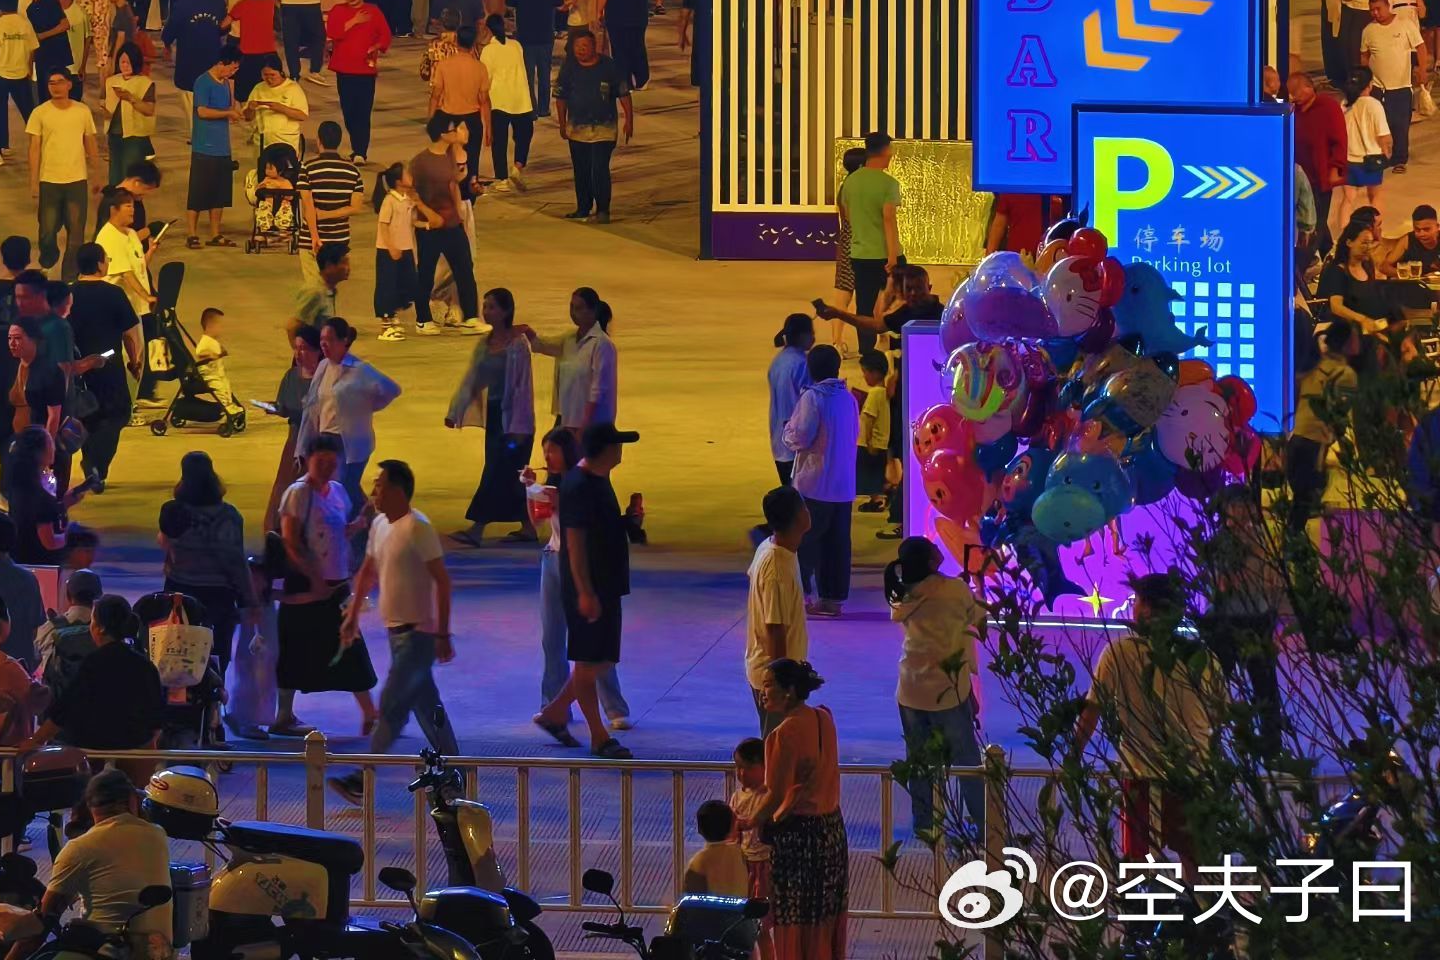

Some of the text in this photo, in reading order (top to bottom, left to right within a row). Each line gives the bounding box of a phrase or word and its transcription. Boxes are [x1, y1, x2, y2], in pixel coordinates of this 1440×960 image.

[1092, 136, 1175, 248] P
[1133, 223, 1225, 255] 停车场
[1131, 255, 1232, 278] Prking lot
